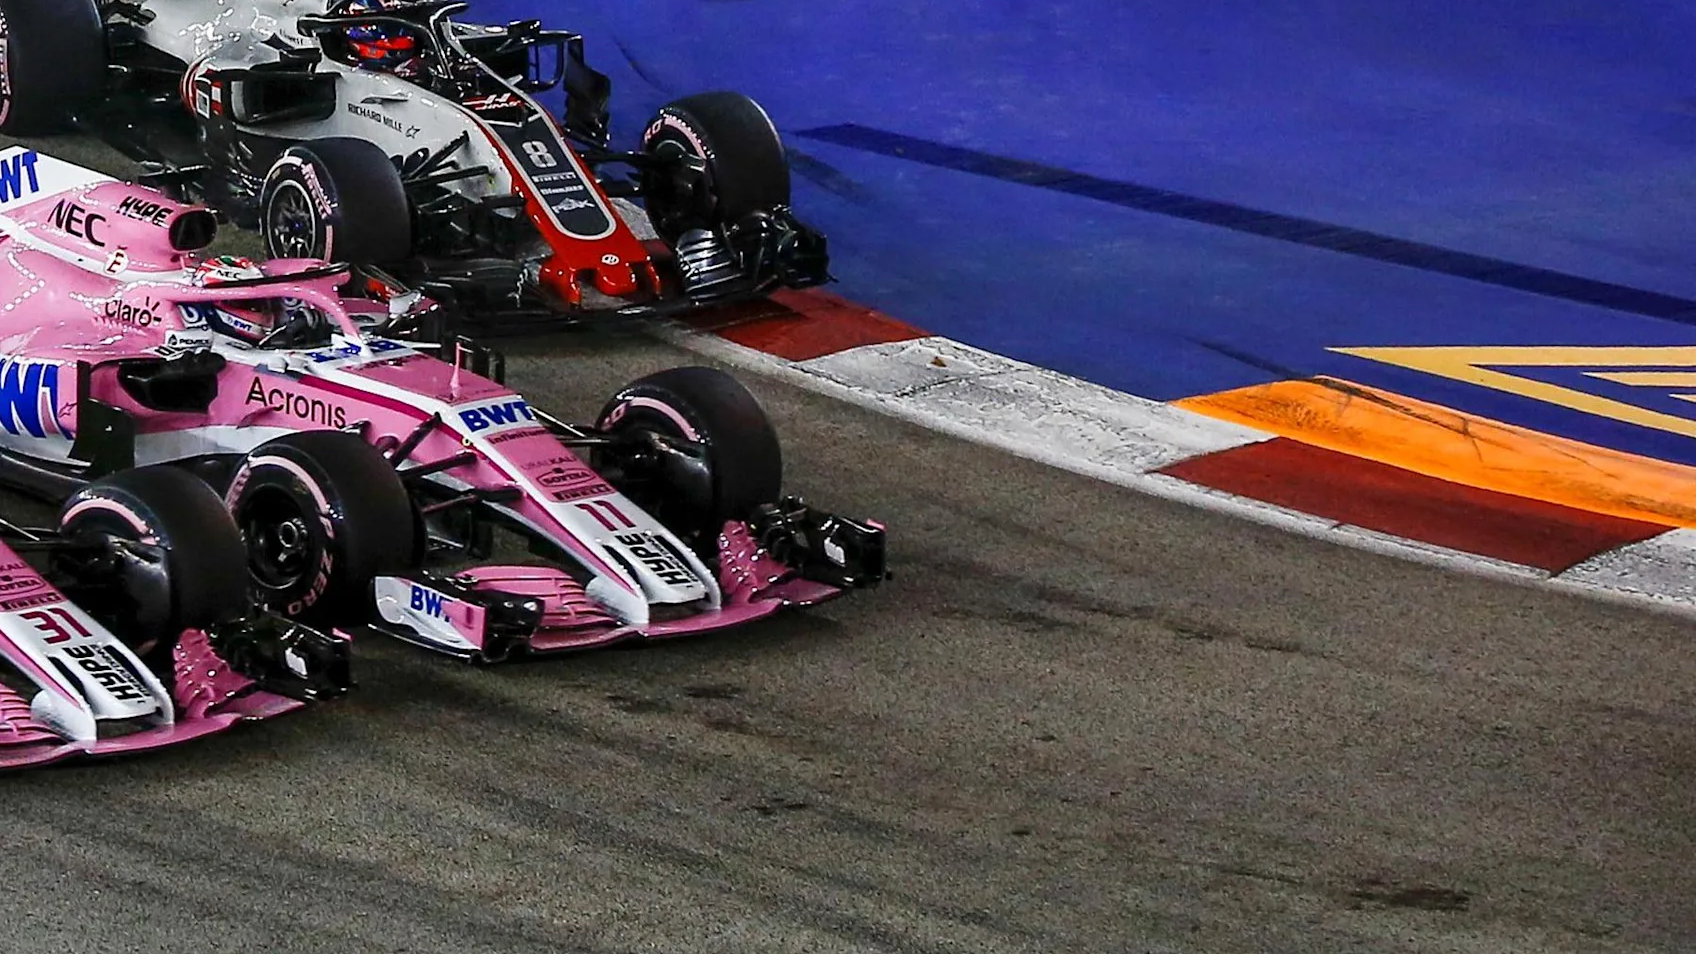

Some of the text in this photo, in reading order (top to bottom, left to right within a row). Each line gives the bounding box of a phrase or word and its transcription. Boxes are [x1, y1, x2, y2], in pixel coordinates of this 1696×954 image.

[347, 103, 403, 133] RICHARD MILLE
[521, 140, 558, 169] 8
[47, 197, 108, 247] NEC
[115, 195, 174, 227] HYPE
[107, 255, 125, 274] E
[215, 269, 242, 279] NEC
[105, 298, 153, 327] Claro
[232, 318, 253, 332] BWT
[245, 376, 347, 430] Acronis
[458, 400, 535, 433] BWT
[574, 499, 637, 532] 11
[614, 532, 692, 585] HYPE
[18, 607, 93, 645] 31
[61, 645, 144, 701] HYPE
